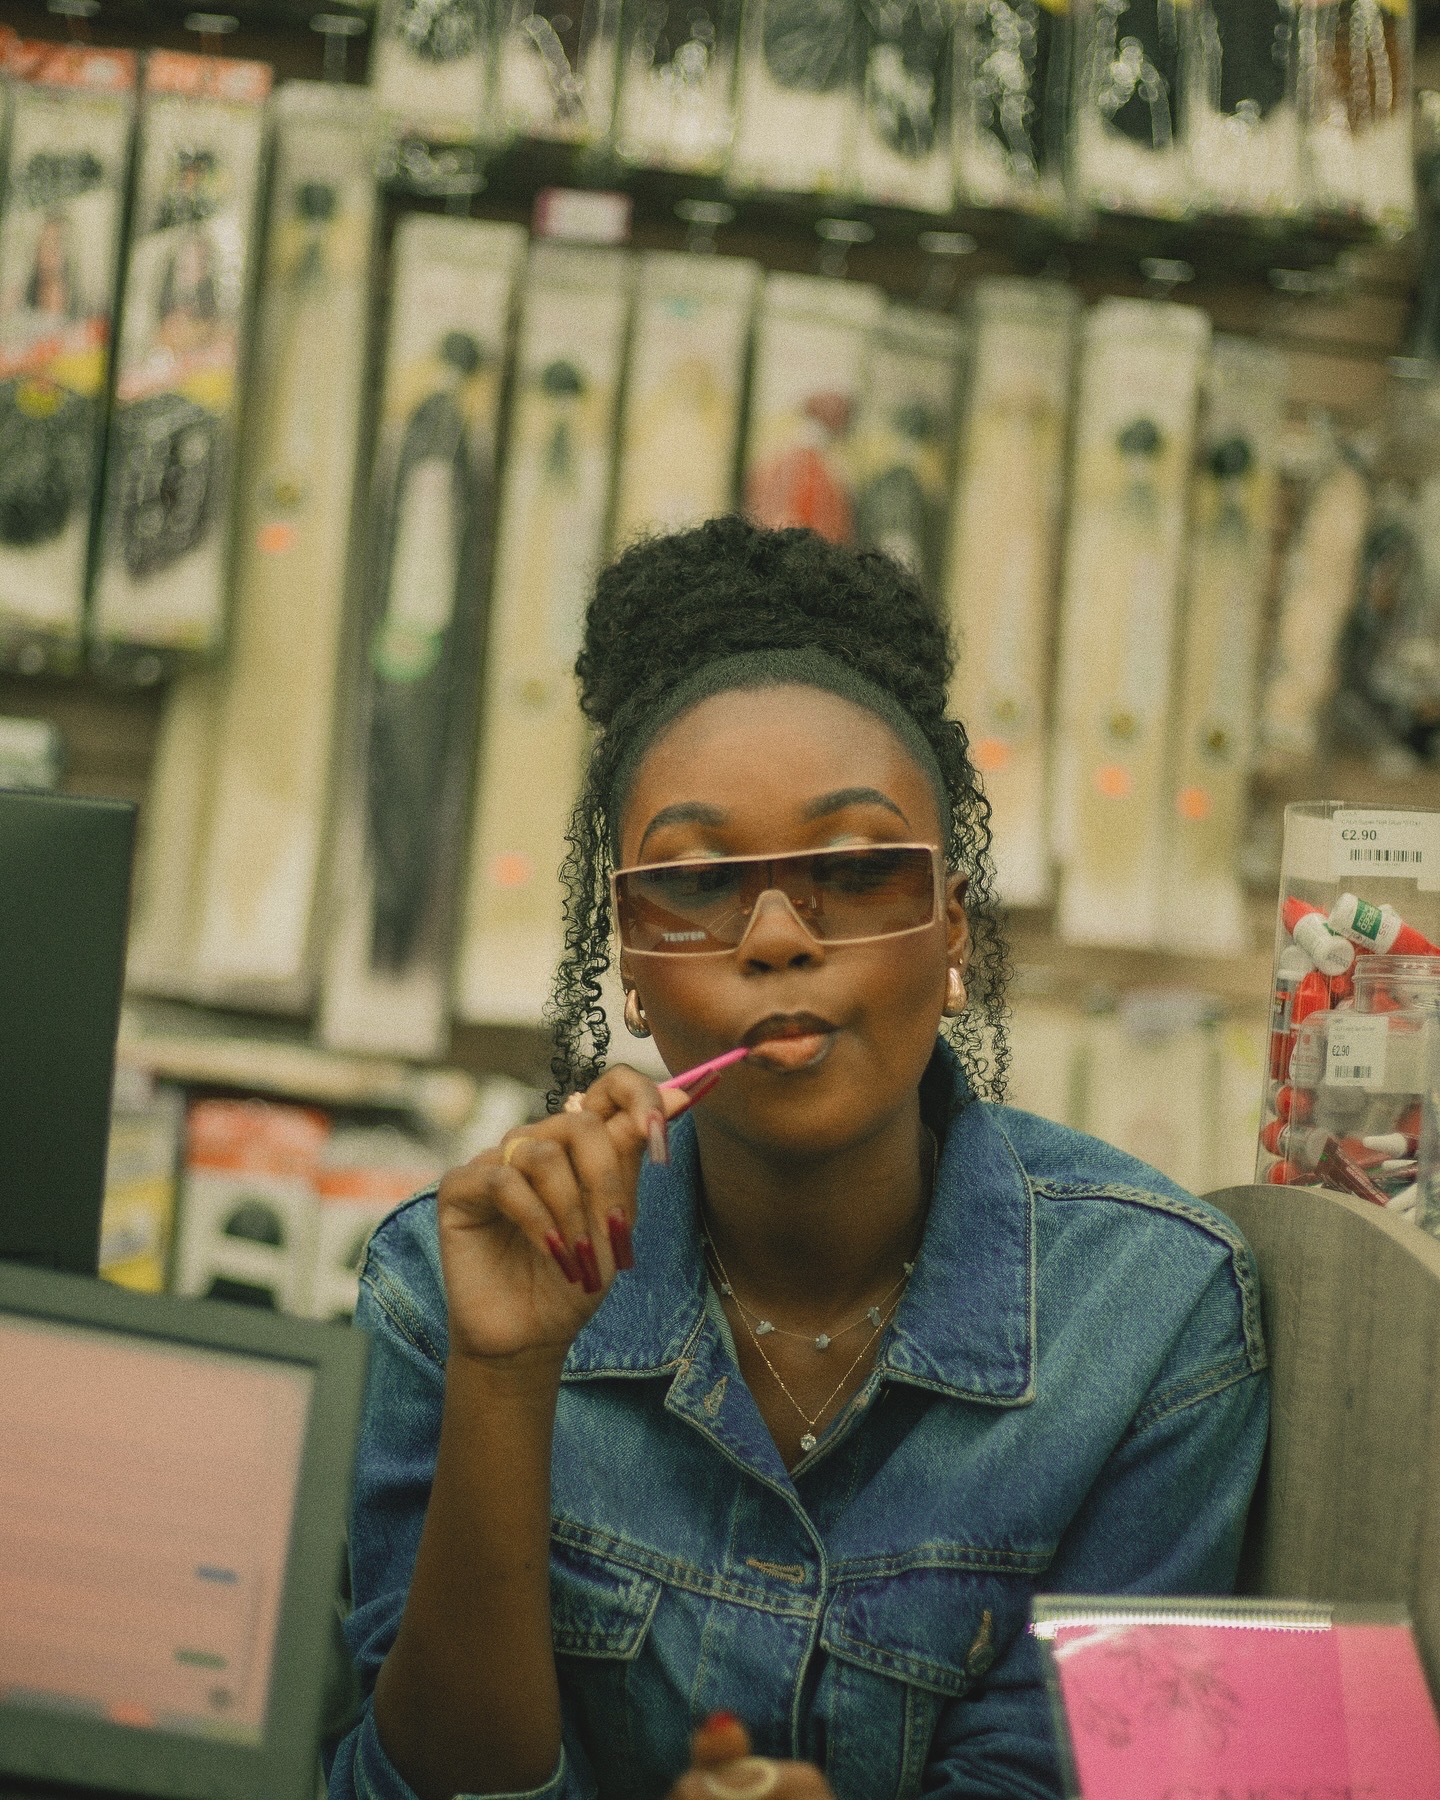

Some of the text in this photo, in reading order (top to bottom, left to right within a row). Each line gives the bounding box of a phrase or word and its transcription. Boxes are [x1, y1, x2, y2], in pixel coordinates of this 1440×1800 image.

[1341, 829, 1377, 841] €2.90
[661, 931, 706, 942] TESTER
[1332, 1045, 1350, 1057] €2.90
